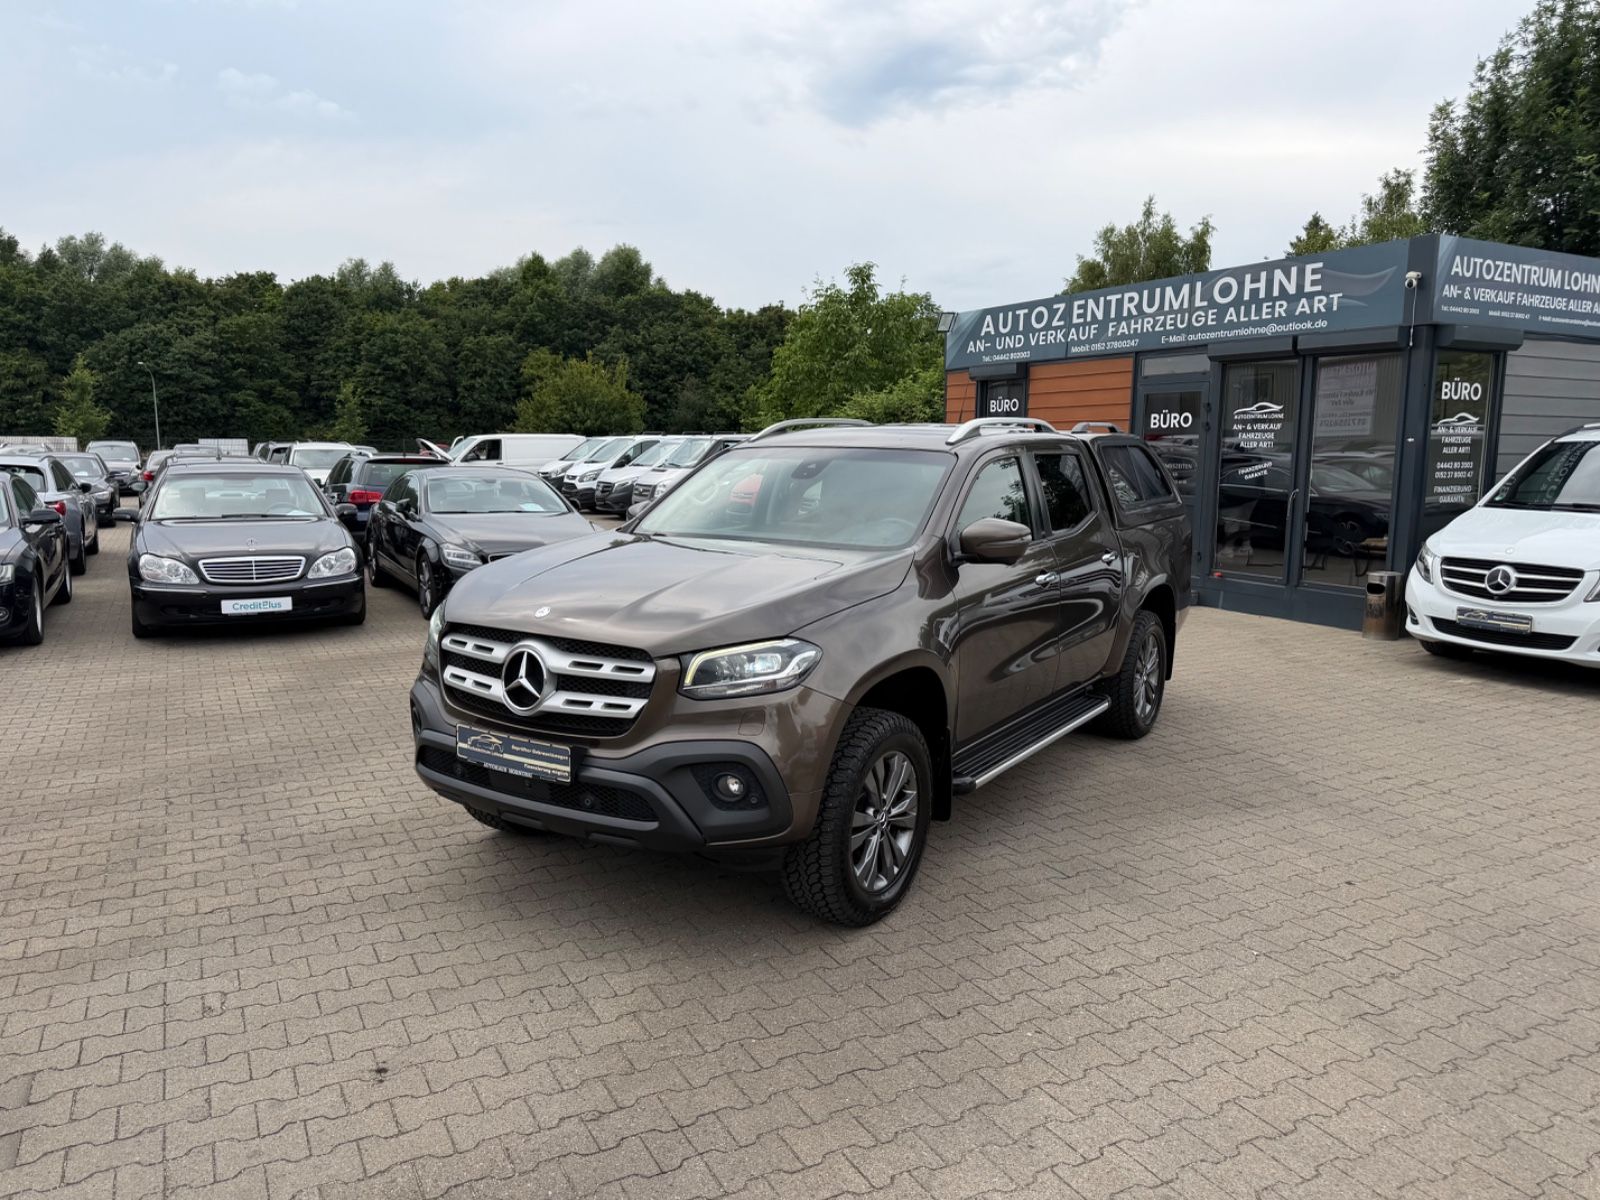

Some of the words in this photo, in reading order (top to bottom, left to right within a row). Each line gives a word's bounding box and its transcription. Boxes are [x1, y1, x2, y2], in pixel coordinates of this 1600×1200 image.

[1451, 255, 1562, 289] AUTOZENTRUM
[1442, 283, 1462, 298] AN-
[1463, 286, 1471, 300] &
[1473, 287, 1516, 304] VERKAUF
[1516, 292, 1568, 311] FAHRZEUGE
[1568, 299, 1592, 313] ALLER
[967, 339, 992, 354] AN-
[996, 334, 1024, 350] UND
[1029, 324, 1099, 346] VERKAUF
[1108, 309, 1217, 337] FAHRZEUGE
[1224, 300, 1288, 323] ALLER
[1295, 292, 1343, 316] ART
[1187, 319, 1328, 341] autozentrumlohne@outlook.de
[1090, 342, 1106, 351] 0152
[1441, 377, 1482, 400] BÜRO
[990, 396, 1019, 412] BÜRO
[1150, 409, 1193, 428] BÜRO
[1441, 436, 1472, 444] FAHRZEUGE
[1442, 446, 1458, 454] ALLER
[1238, 461, 1273, 475] FINANZIERUNG
